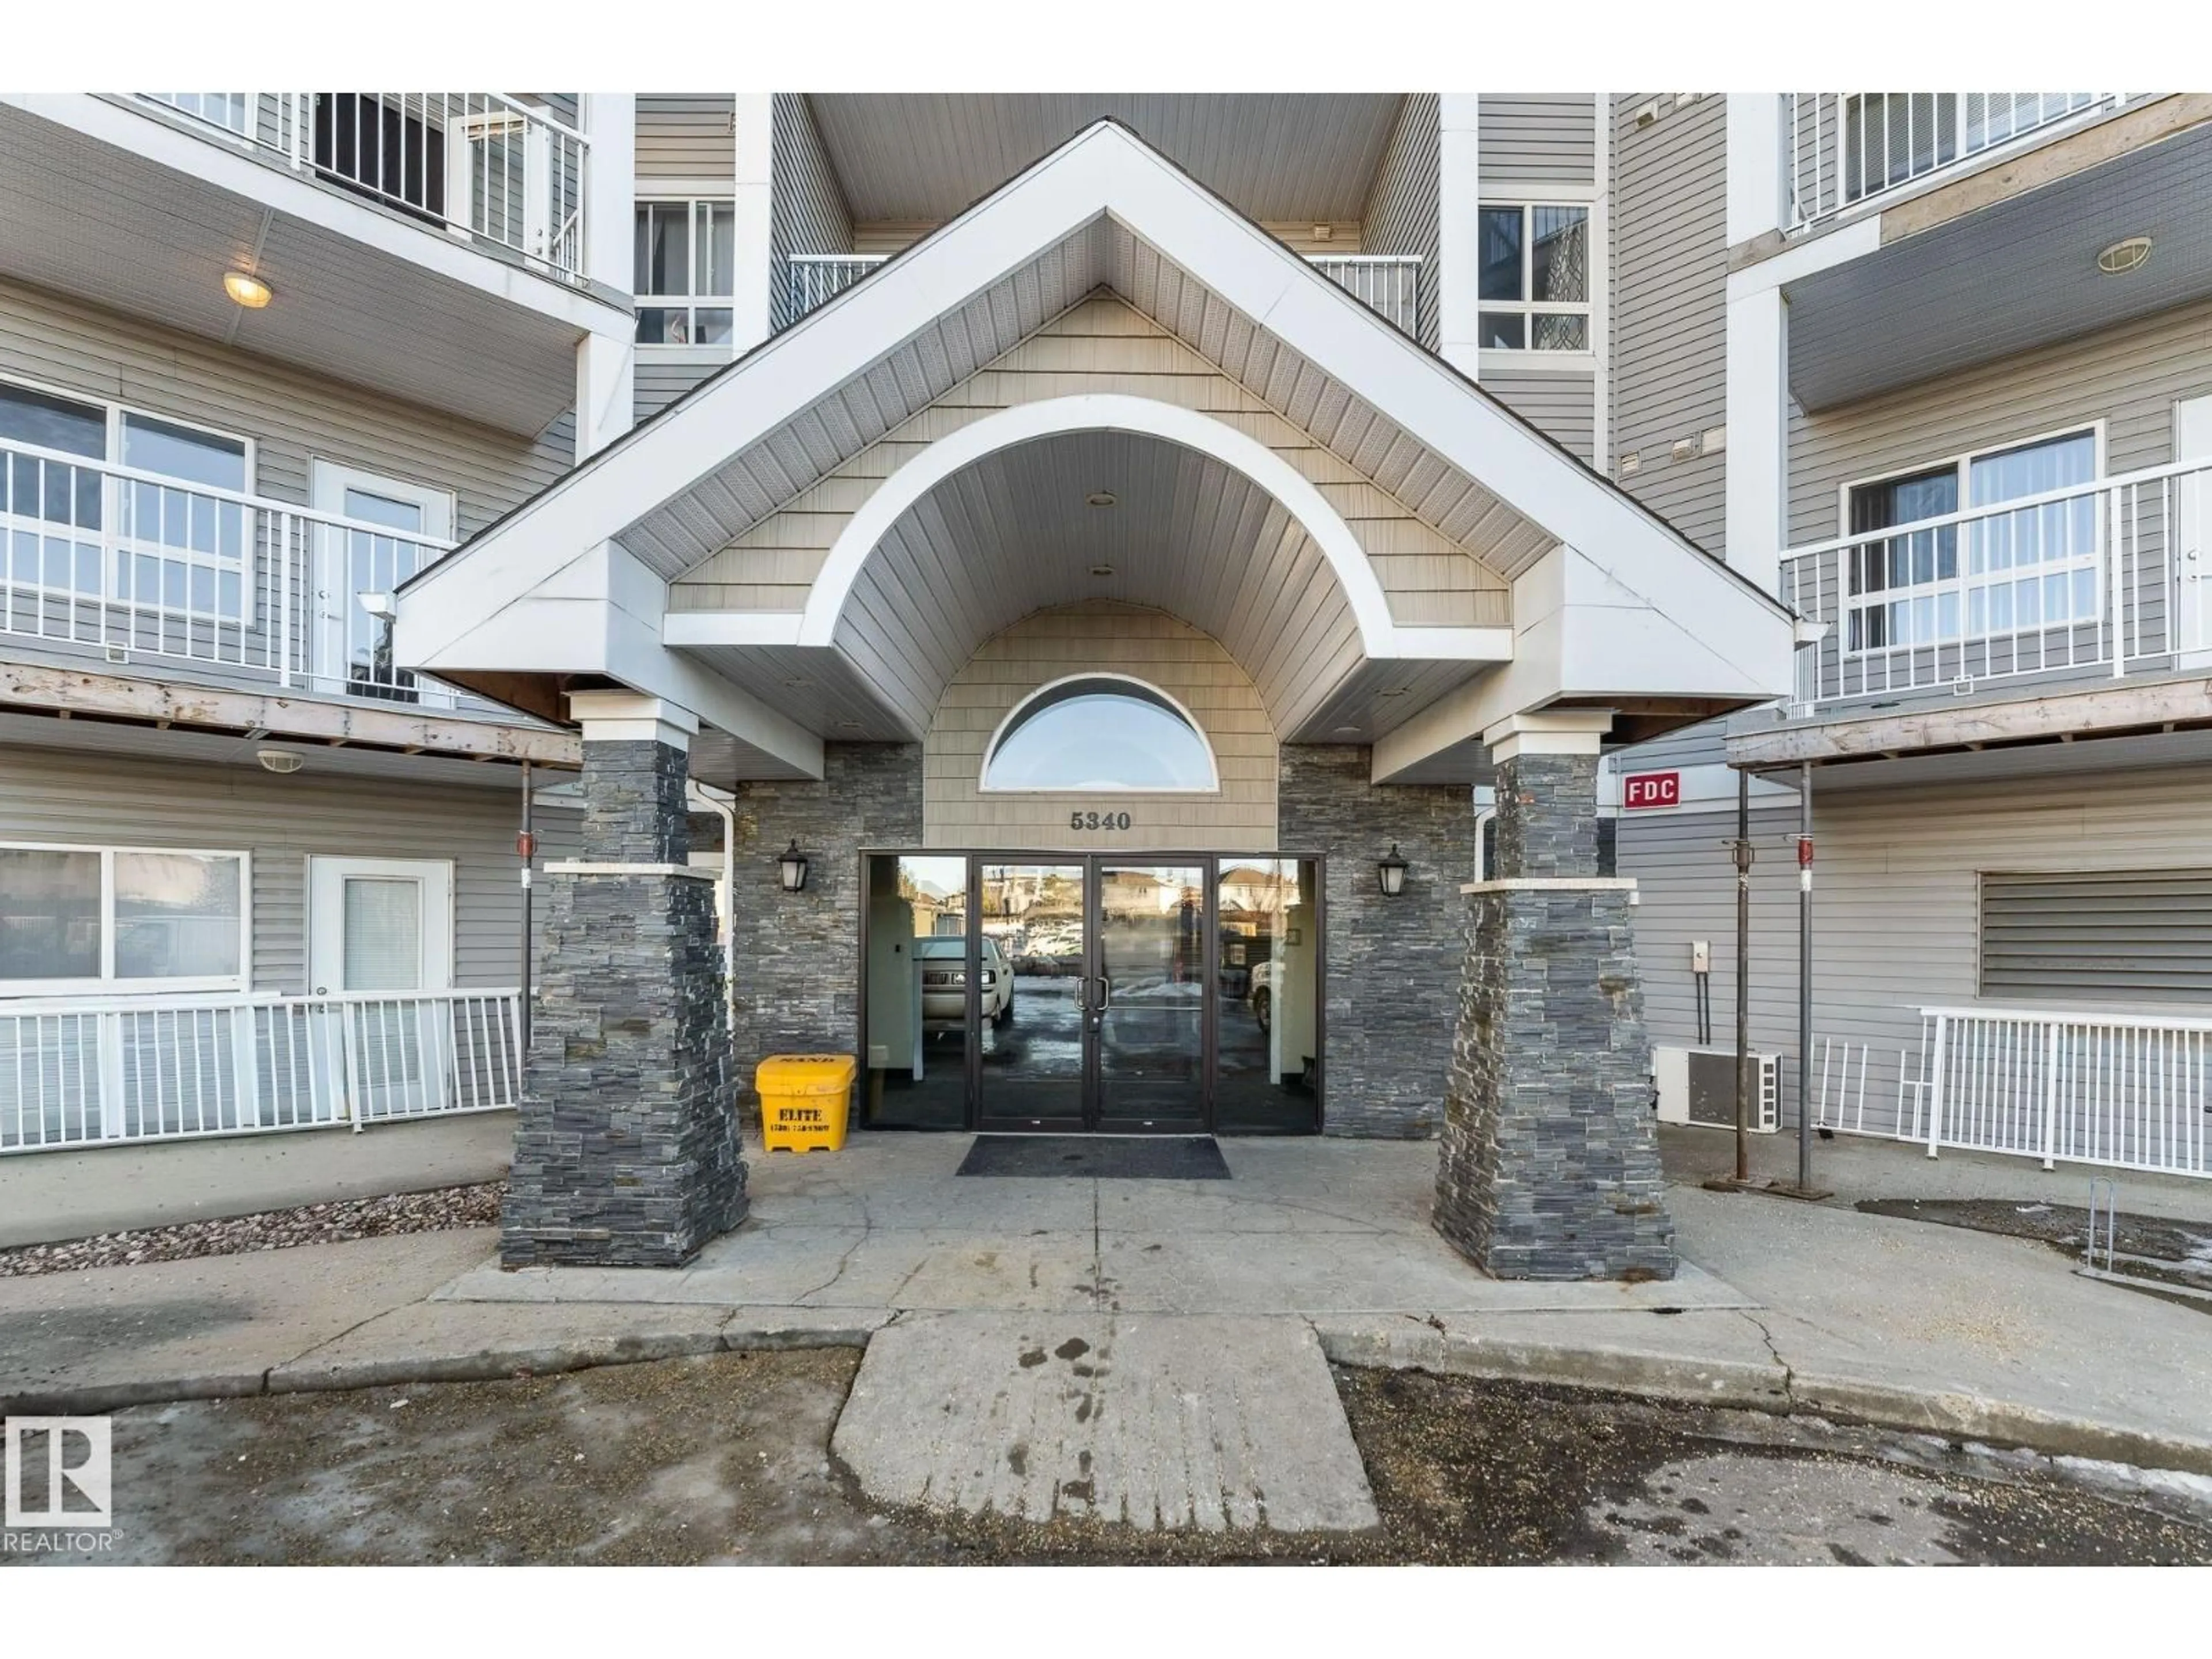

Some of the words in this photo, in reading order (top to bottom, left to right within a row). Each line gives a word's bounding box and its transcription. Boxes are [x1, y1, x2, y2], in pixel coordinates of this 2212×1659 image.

[1628, 779, 1674, 802] FDC
[1071, 812, 1131, 830] 5340
[779, 1108, 822, 1122] ELITE
